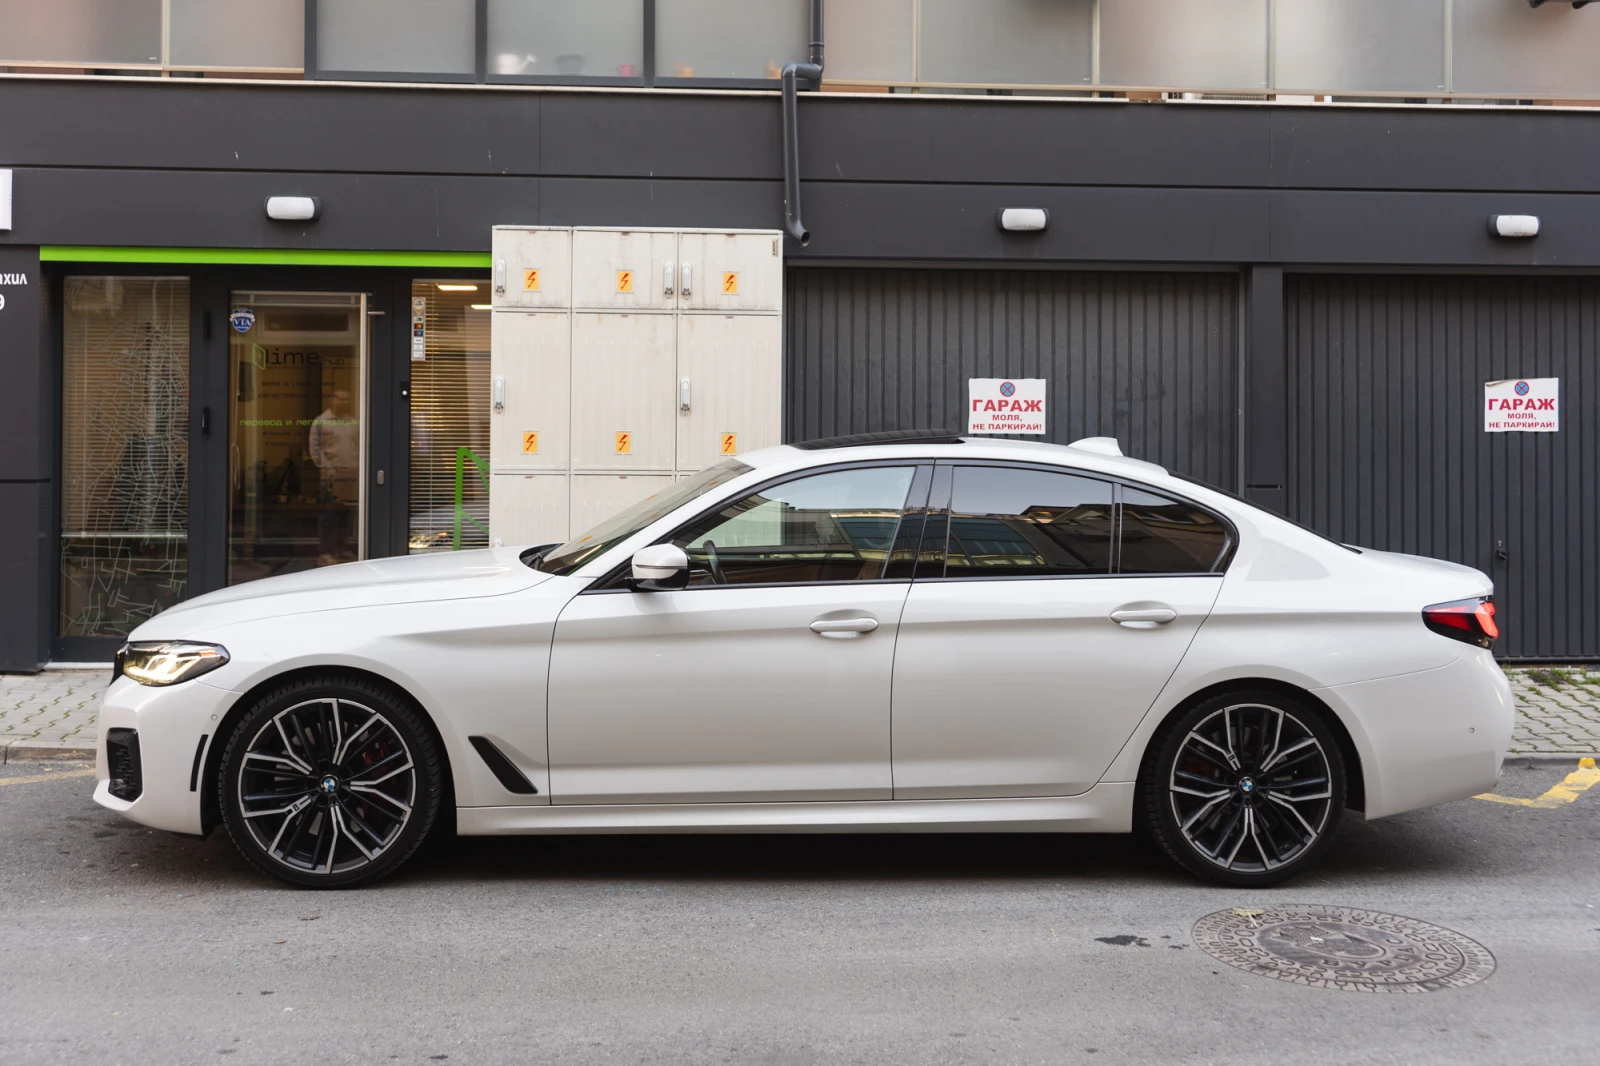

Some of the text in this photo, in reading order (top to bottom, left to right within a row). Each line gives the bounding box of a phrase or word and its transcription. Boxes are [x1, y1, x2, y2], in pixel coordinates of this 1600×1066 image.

[265, 347, 320, 365] lime
[972, 399, 1042, 412] ГАРАЖ
[1488, 398, 1555, 411] ГАРАЖ
[992, 414, 1023, 422] МОЛЯ,
[239, 419, 283, 428] перевод
[286, 419, 293, 427] и
[972, 423, 1042, 431] НЕ ПАРКИРАЙ!
[1488, 421, 1555, 429] НЕ ПАРКИРАЙ!
